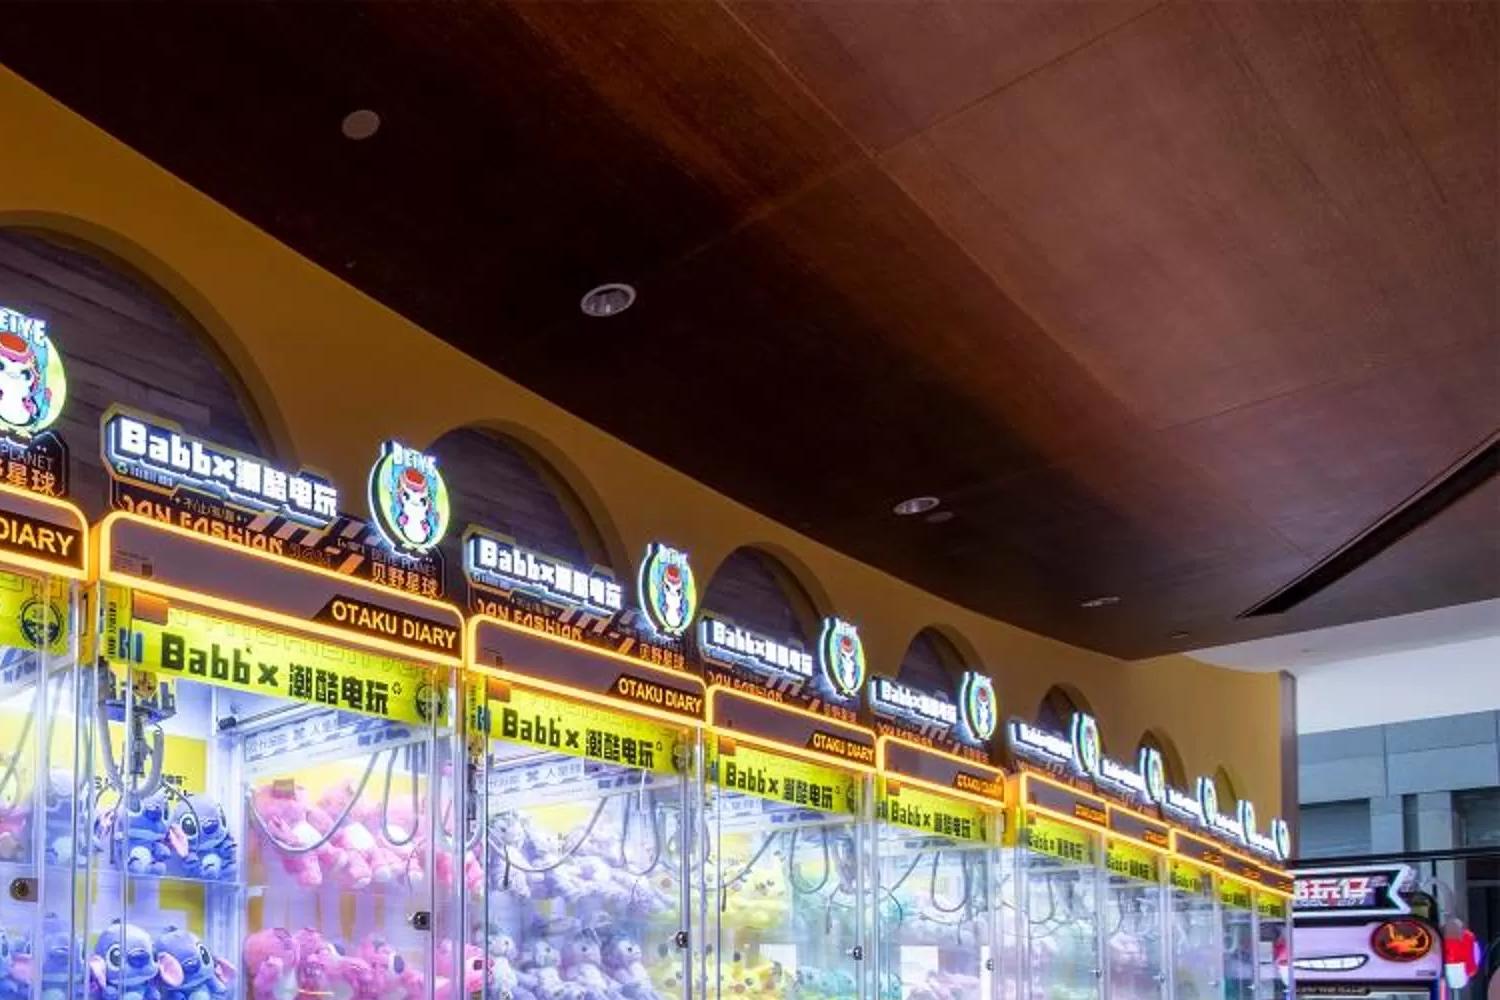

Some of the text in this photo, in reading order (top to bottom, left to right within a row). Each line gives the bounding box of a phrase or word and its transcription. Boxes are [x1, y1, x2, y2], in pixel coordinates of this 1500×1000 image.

[331, 600, 457, 650] OTAKU DIARY
[288, 661, 389, 716] 潮酷电玩
[618, 676, 702, 714] OTAKU DIARY
